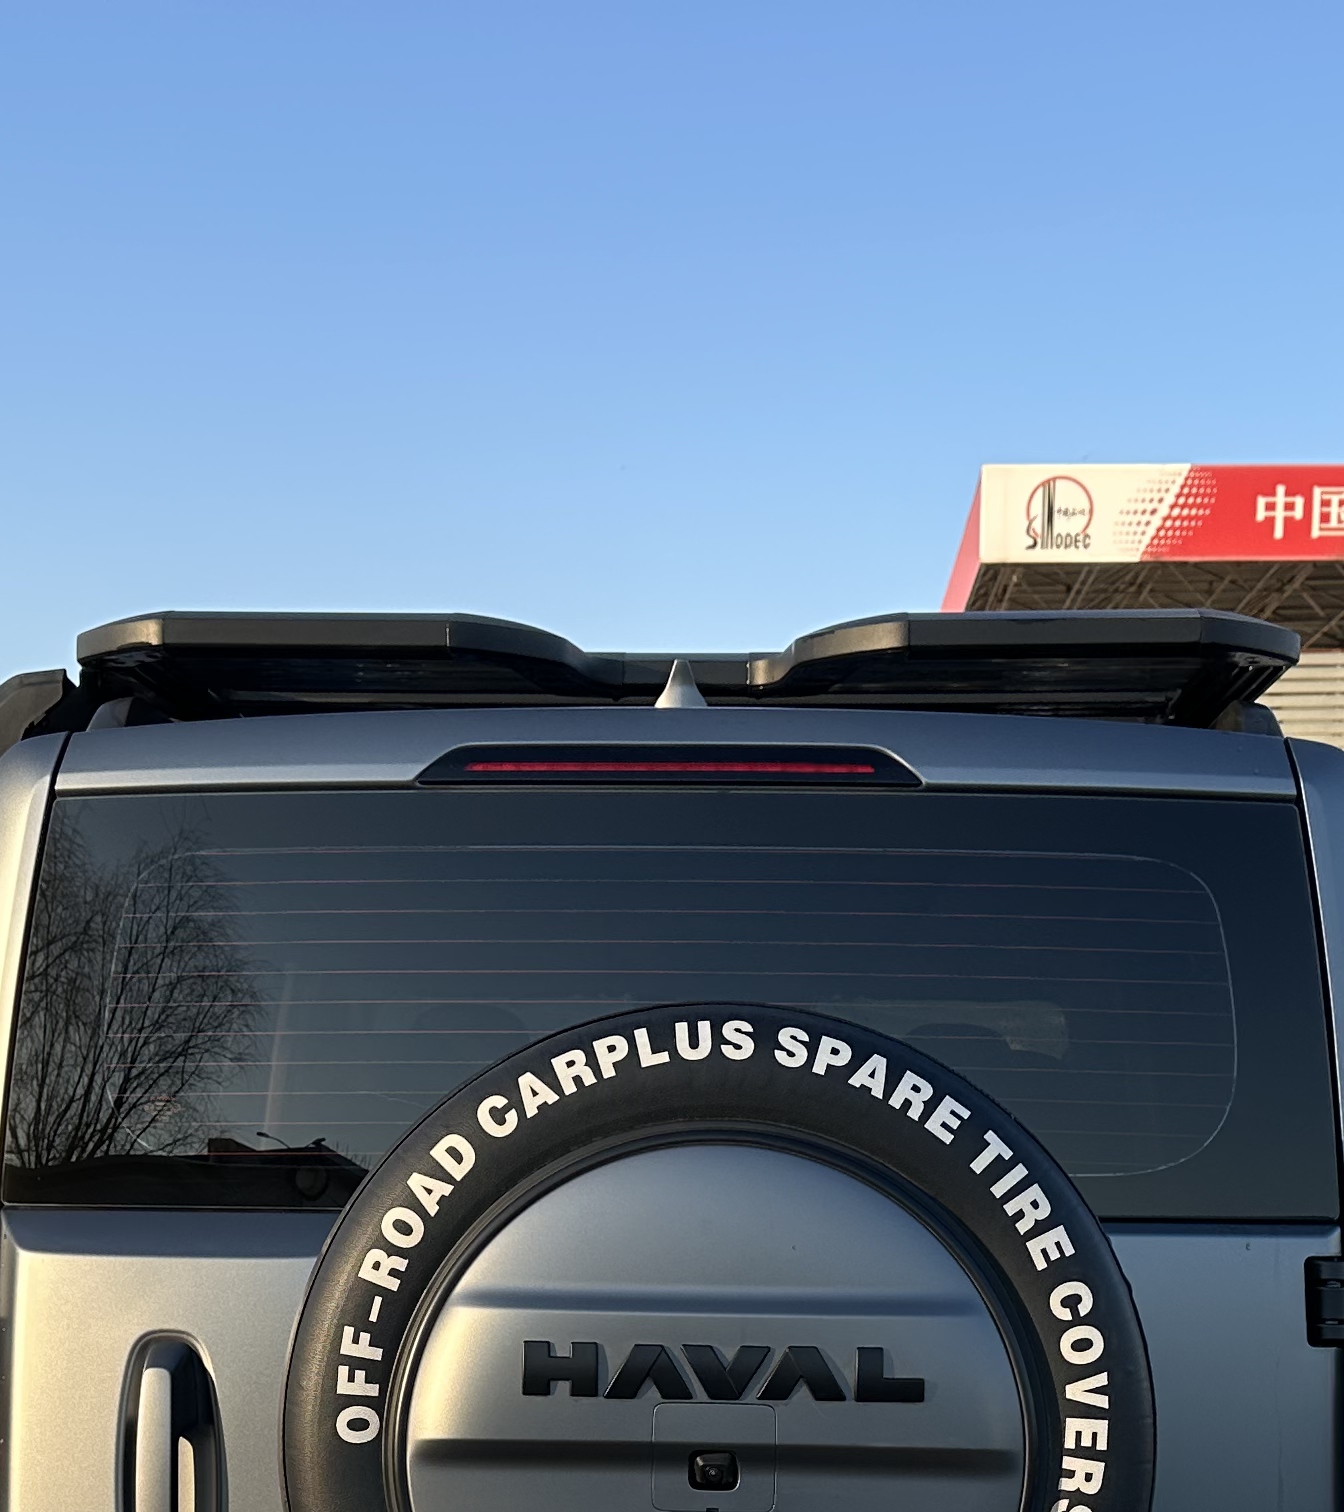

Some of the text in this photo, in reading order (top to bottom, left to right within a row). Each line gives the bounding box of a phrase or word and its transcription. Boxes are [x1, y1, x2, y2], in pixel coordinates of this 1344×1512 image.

[336, 1131, 478, 1445] OFF-ROAD
[475, 1019, 755, 1139] CARPLUS
[774, 1027, 973, 1144] SPARE
[970, 1129, 1076, 1272] TIRE
[521, 1339, 927, 1404] HAVAL
